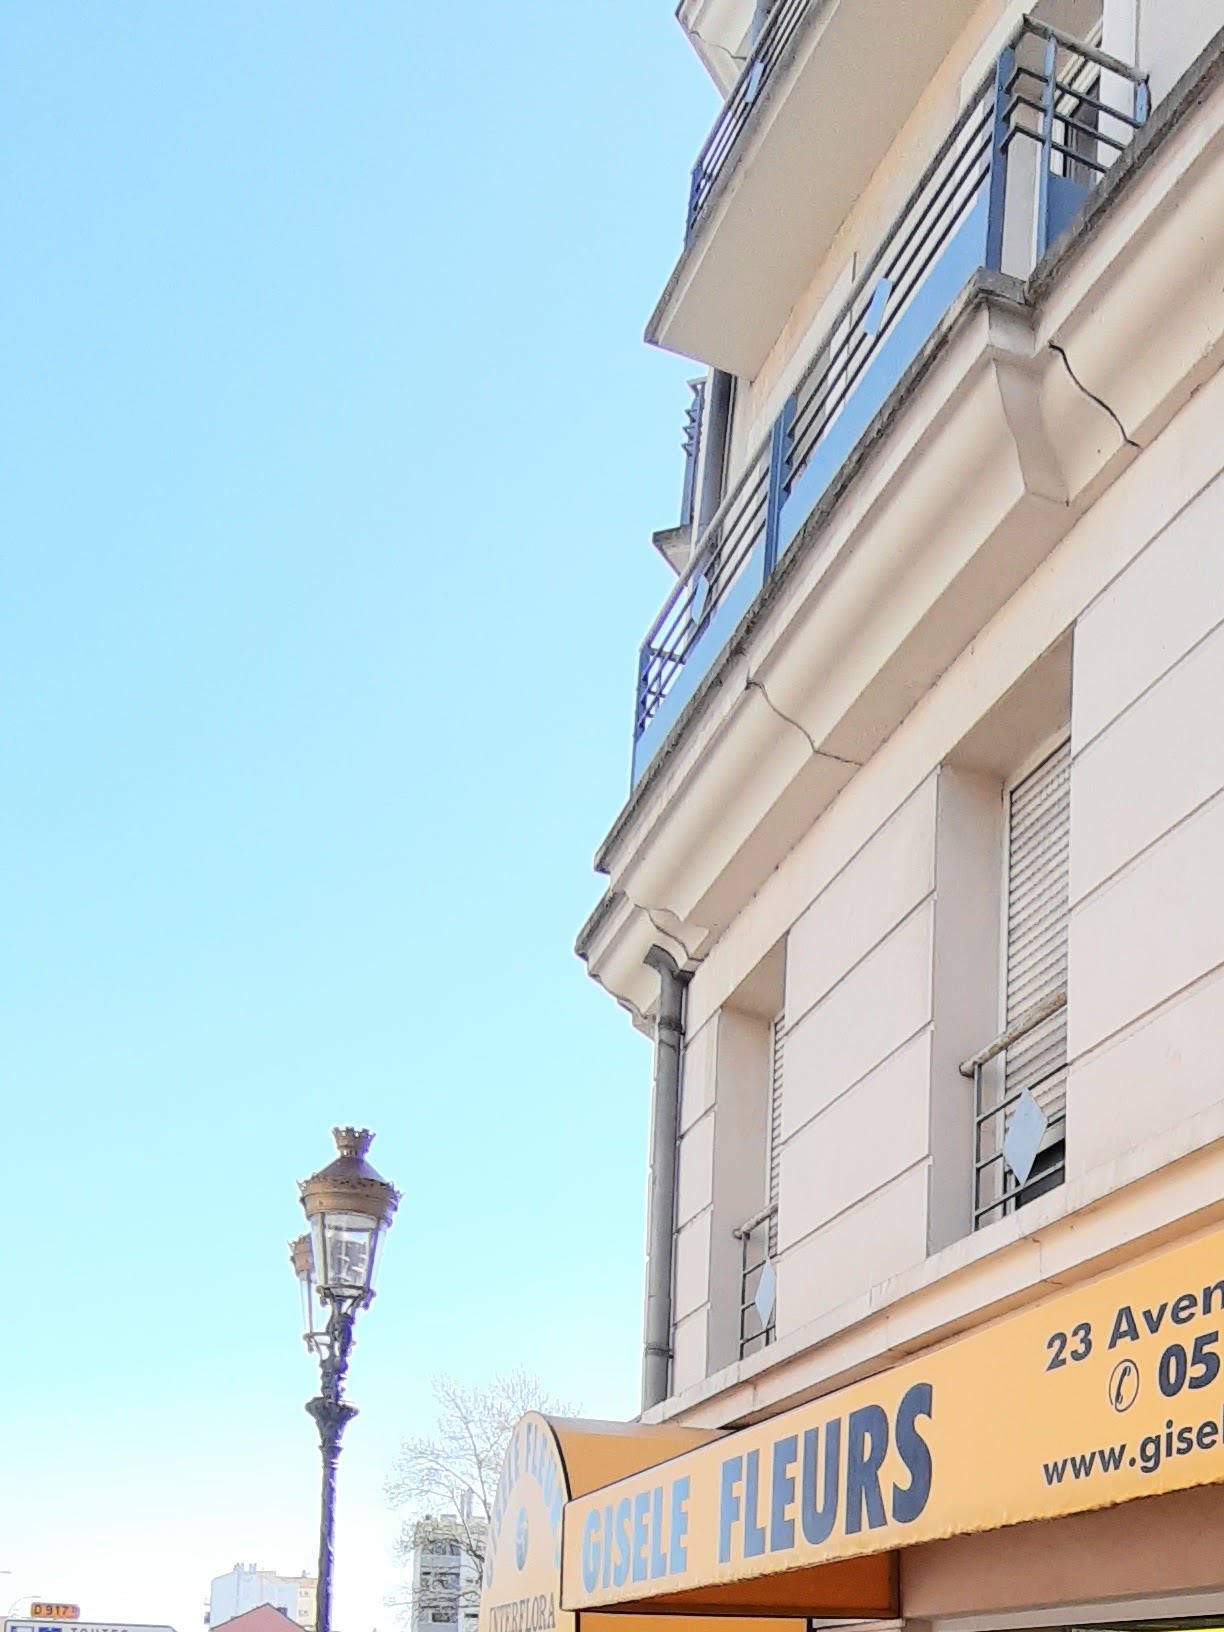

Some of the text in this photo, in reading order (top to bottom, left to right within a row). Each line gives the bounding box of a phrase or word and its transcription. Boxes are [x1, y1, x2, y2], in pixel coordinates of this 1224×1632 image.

[1046, 1323, 1093, 1373] 23
[1157, 1330, 1221, 1399] 05
[582, 1382, 933, 1594] GISELE FLEURS
